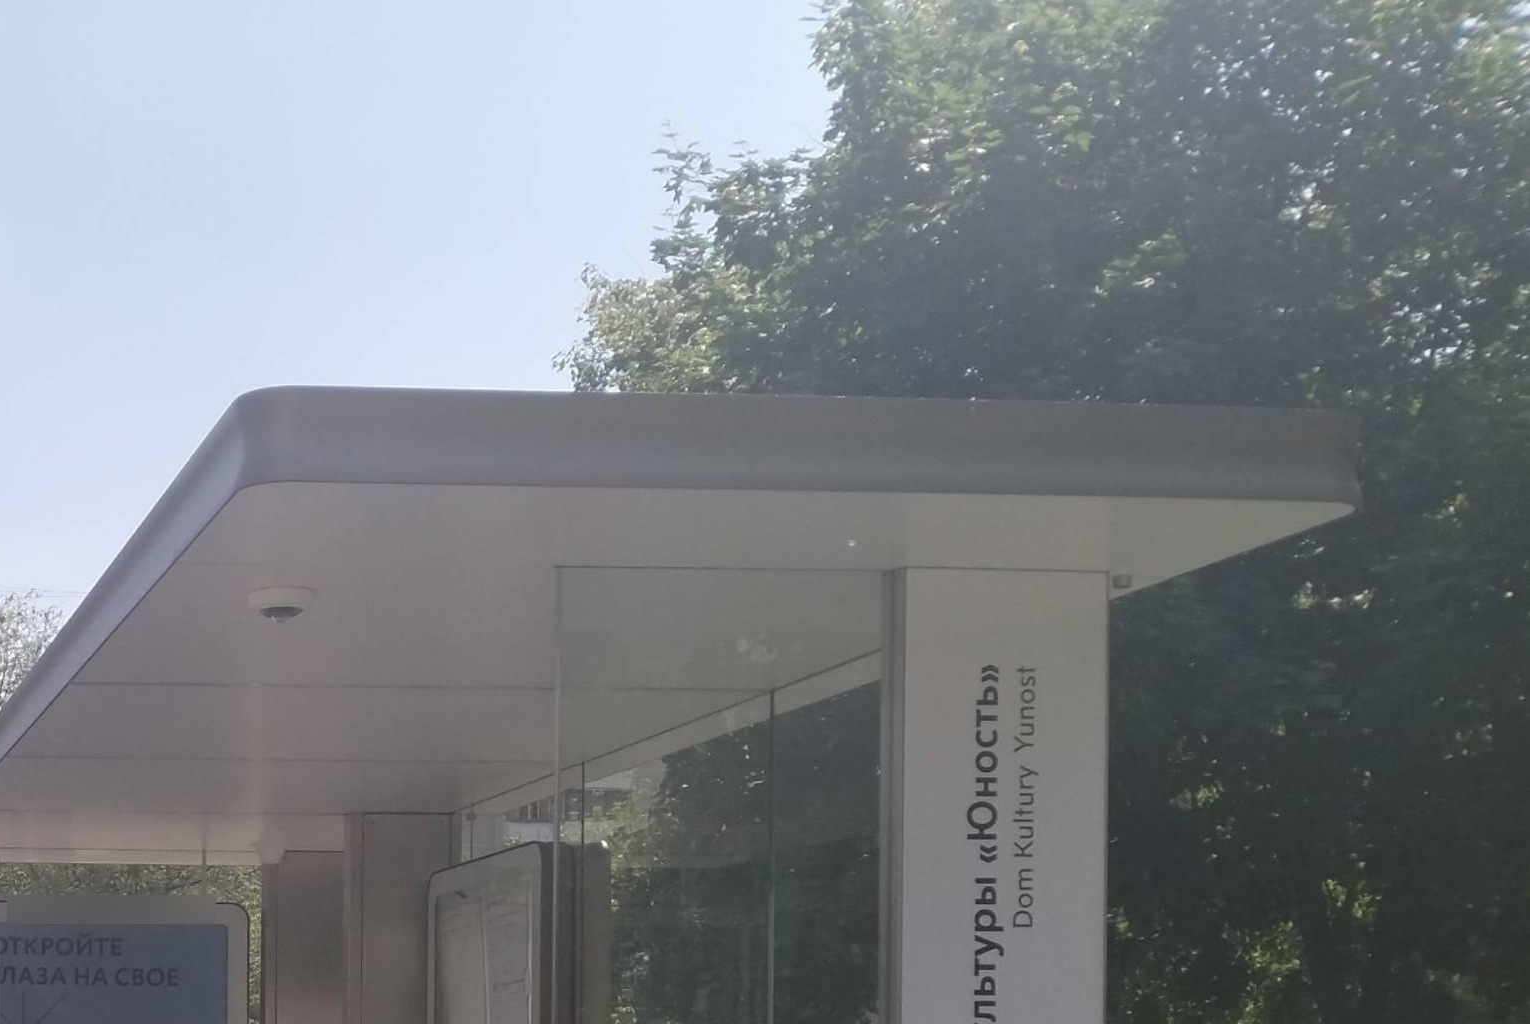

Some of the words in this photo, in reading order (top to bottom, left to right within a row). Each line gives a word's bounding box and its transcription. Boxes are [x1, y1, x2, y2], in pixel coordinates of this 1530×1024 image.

[1012, 666, 1036, 754] Yunost
[966, 664, 1000, 863] «Юность»
[1012, 765, 1040, 858] Kultury
[1012, 868, 1034, 929] Dom
[74, 966, 108, 987] НА
[114, 967, 180, 988] СВОЕ
